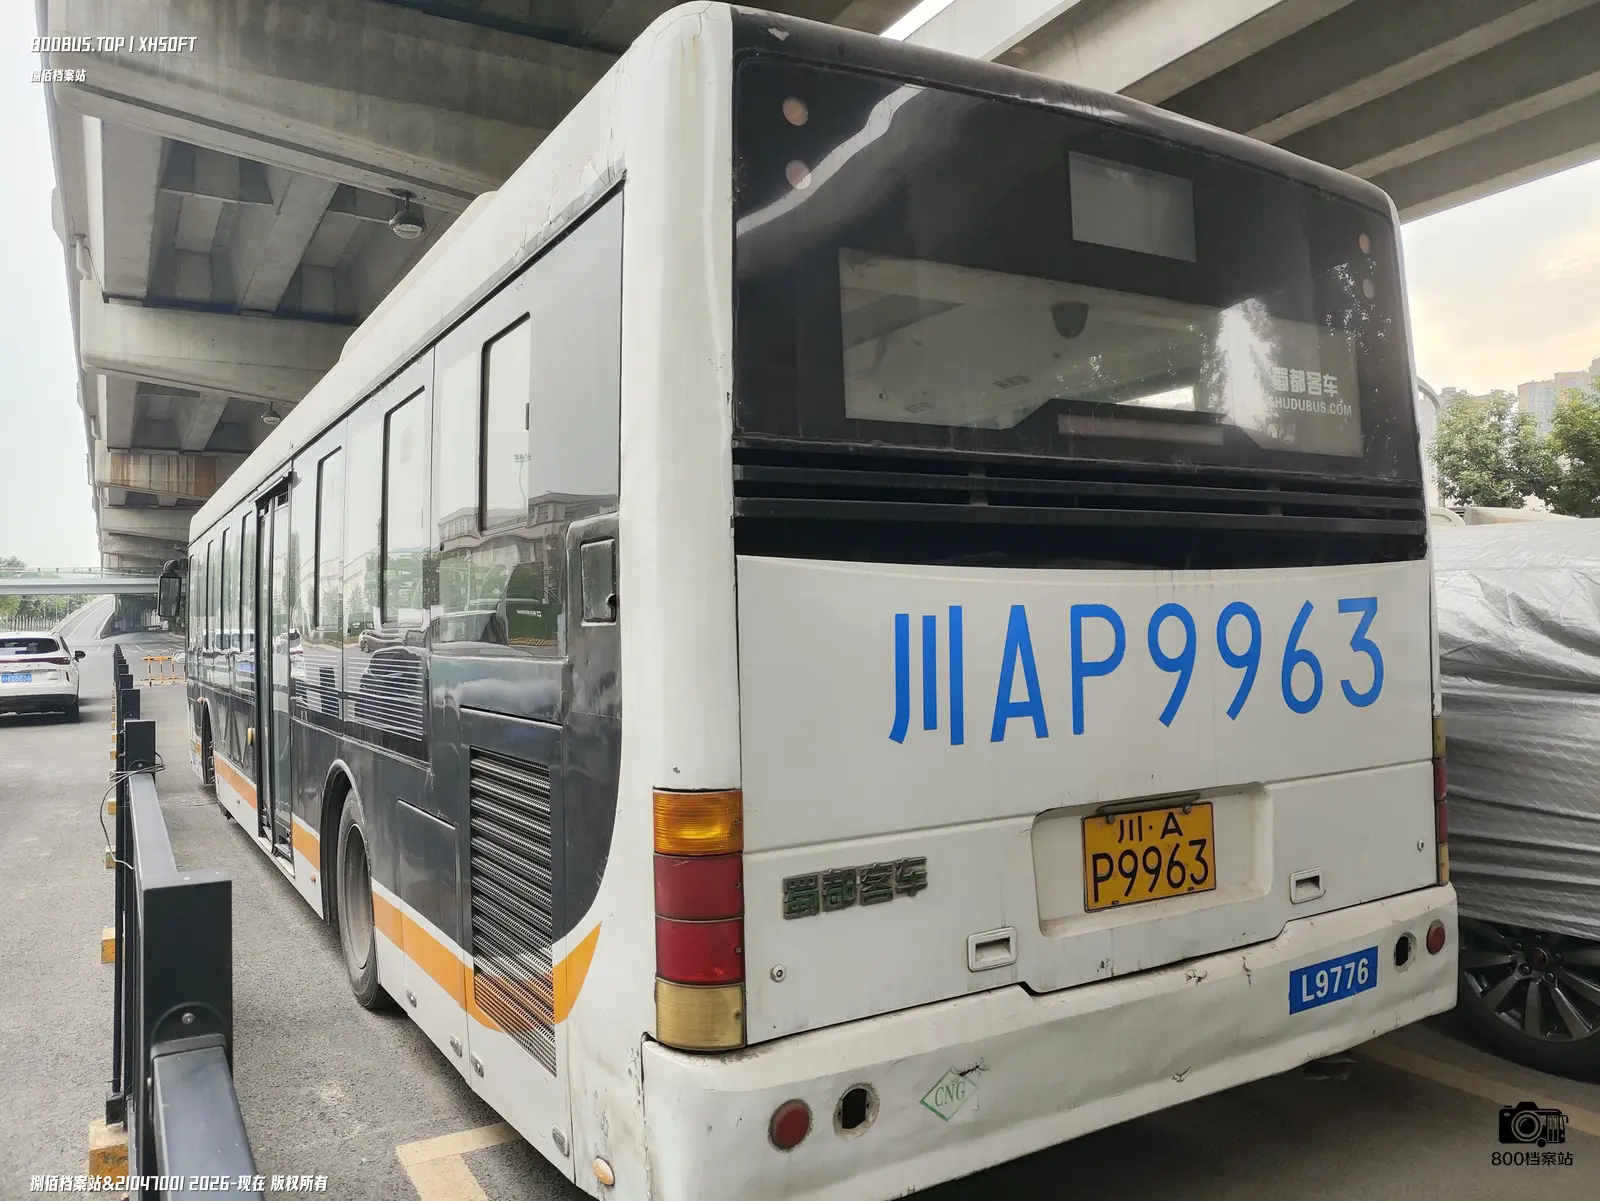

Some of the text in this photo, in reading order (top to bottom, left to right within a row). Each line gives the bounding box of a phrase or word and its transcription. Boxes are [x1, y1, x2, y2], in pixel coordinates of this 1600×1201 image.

[1272, 366, 1339, 398] 蜀都客车
[888, 597, 1384, 746] 川AP9963
[1092, 838, 1209, 903] P9963
[1302, 958, 1369, 1003] L9776
[934, 1081, 966, 1107] CNG
